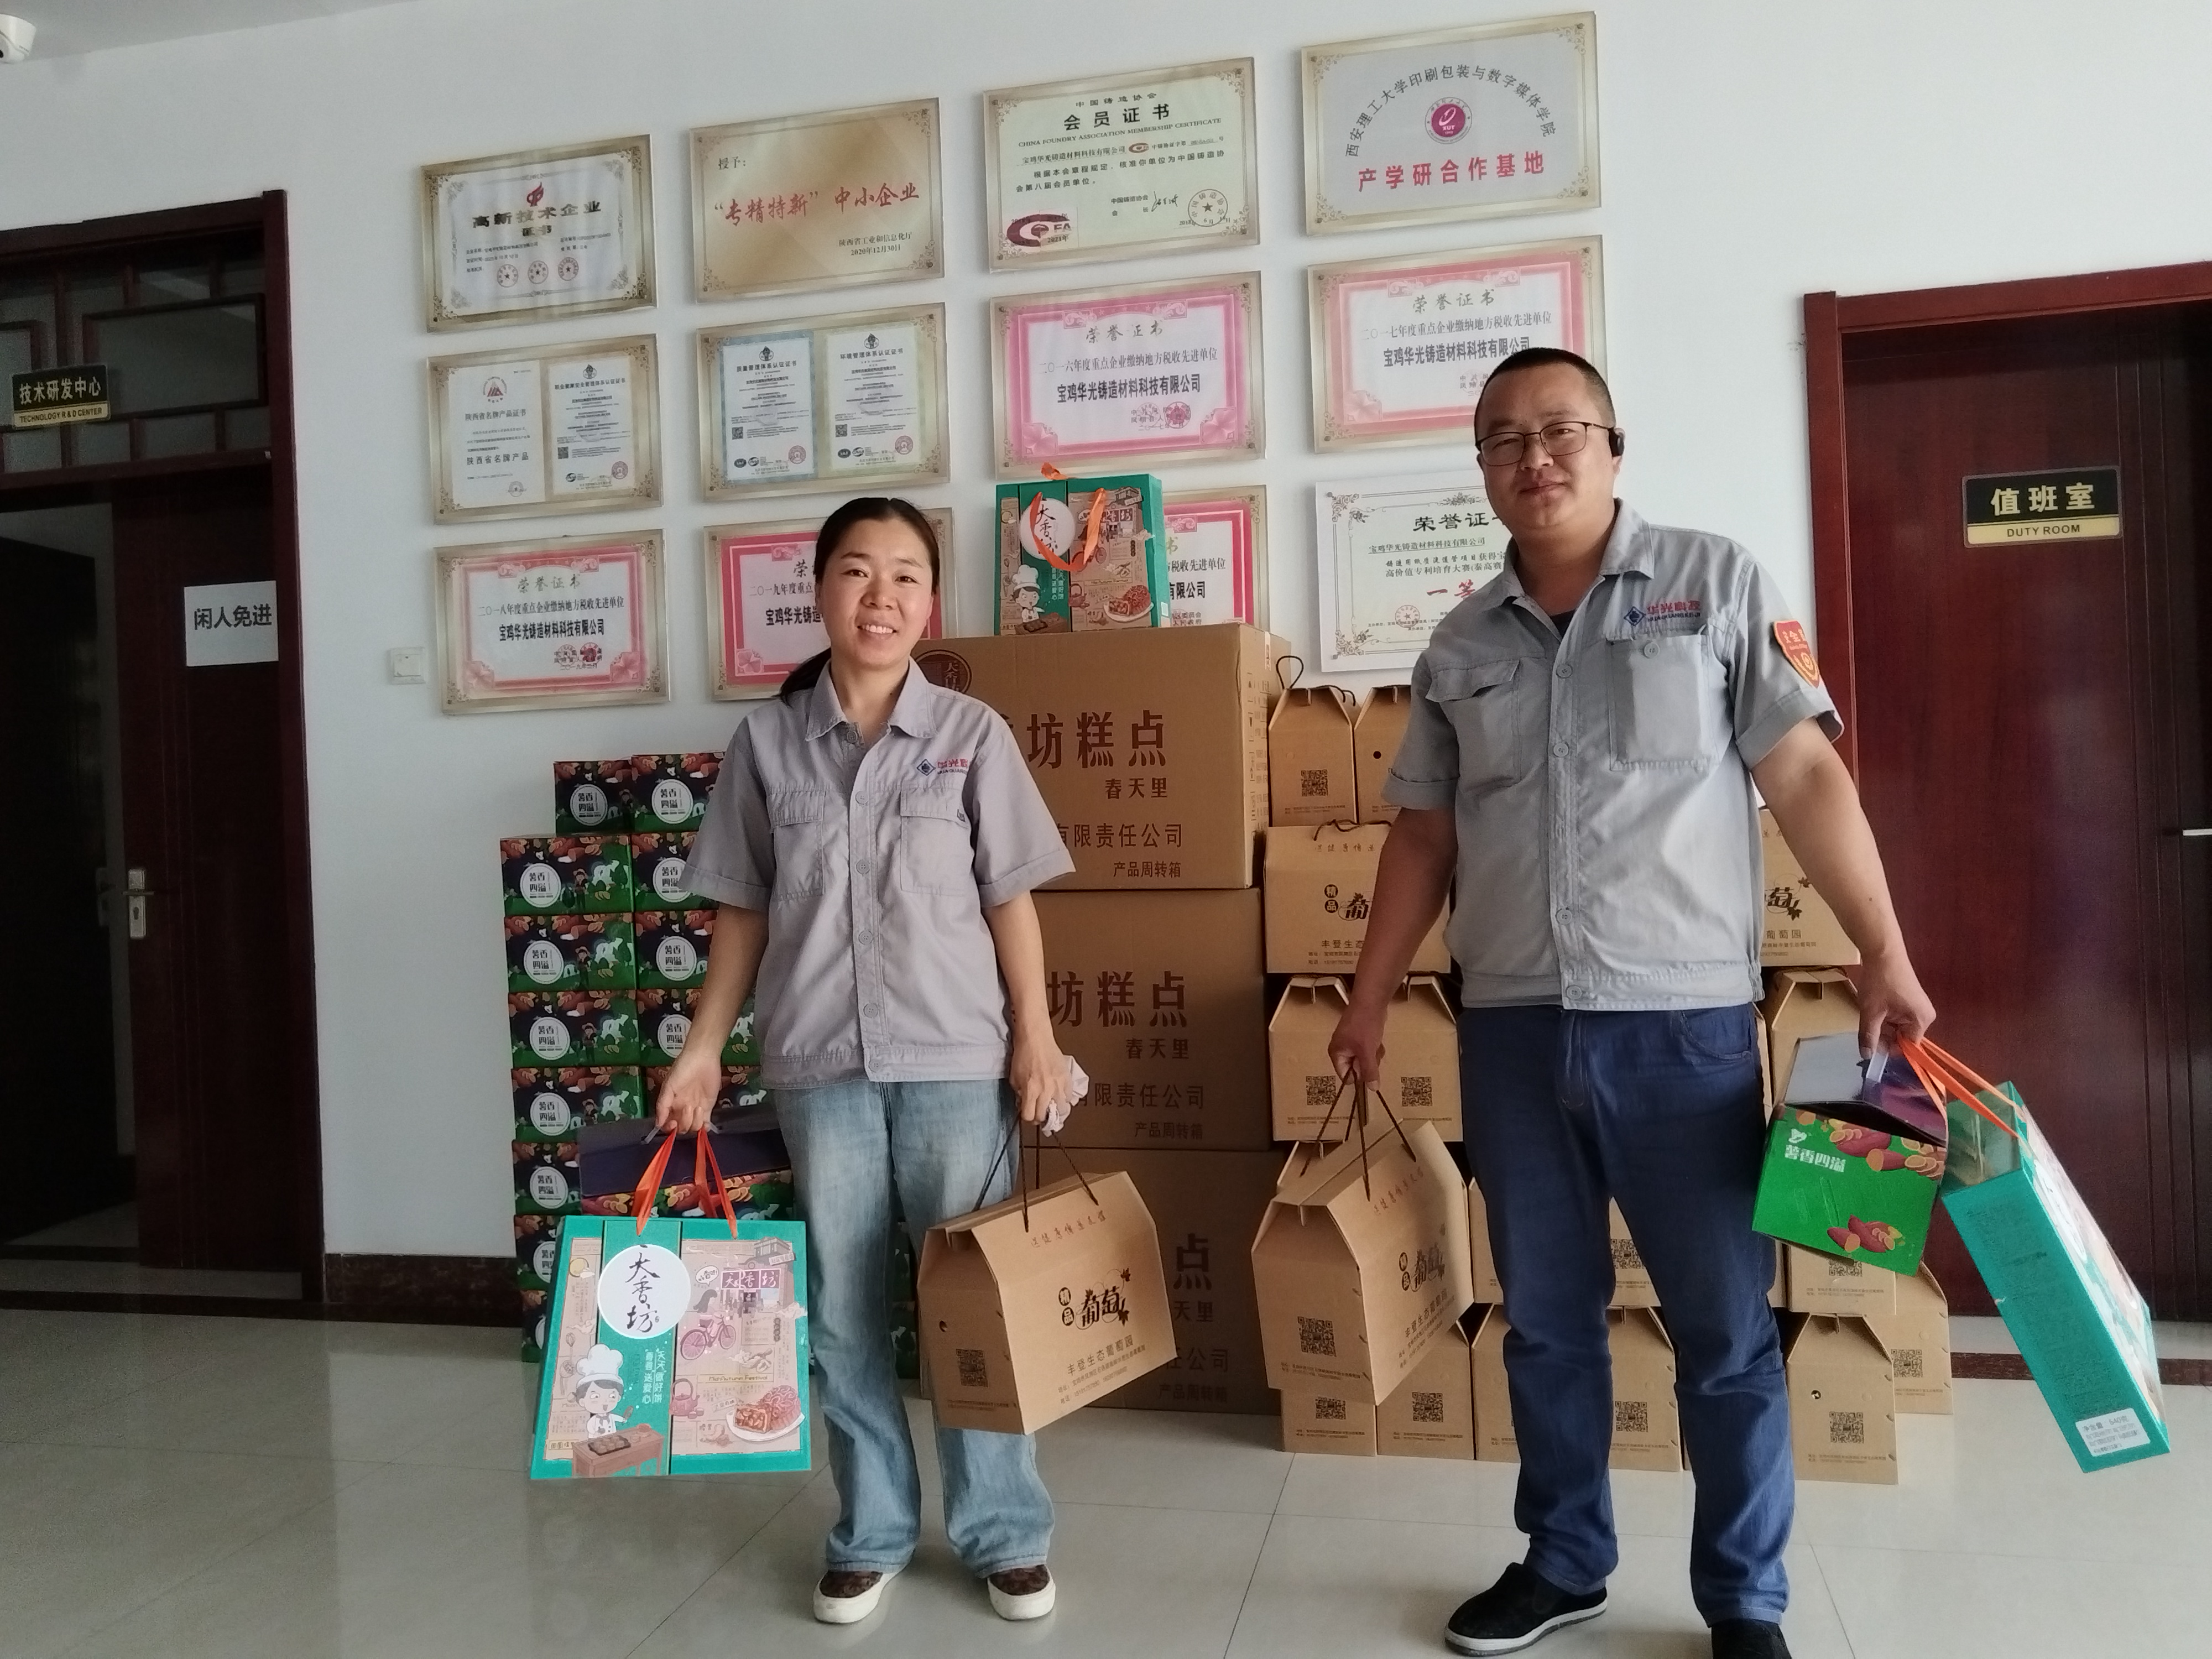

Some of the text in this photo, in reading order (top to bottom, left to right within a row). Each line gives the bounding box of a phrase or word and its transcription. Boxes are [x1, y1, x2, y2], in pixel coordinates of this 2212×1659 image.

[1076, 92, 1157, 108] 中国铸造协会
[1345, 64, 1557, 158] 西安理工大学印刷包装与数字媒体学院
[1064, 103, 1170, 131] 会员证书
[1019, 117, 1222, 148] CHINA FOUNDRY ASSOCIATION MEMBERSHIP CERTIFICATE
[1022, 145, 1126, 164] 宝鸡华光铸造材料科技有限公司
[1358, 150, 1545, 192] 产学研合作基地
[834, 182, 920, 214] 中小企业
[472, 200, 601, 228] 高新技术企业
[839, 232, 912, 247] 陕西省工业和信息化厅
[1412, 288, 1495, 314] 荣誉证书
[1086, 320, 1163, 343] 荣誉证书
[1384, 336, 1530, 367] 宝鸡华光铸造材料科技有限公司
[19, 376, 101, 405] 技术研发中心
[1057, 373, 1201, 404] 宝鸡华光铸造材料科技有限公司
[19, 411, 61, 423] TECHNOLOGY
[78, 407, 102, 417] CENTER
[466, 452, 529, 466] 陕西省名牌产品
[1990, 482, 2095, 516] 值班室
[1413, 512, 1502, 531] 荣誉证
[2007, 524, 2080, 538] DUTY ROOM
[1369, 537, 1485, 554] 宝鸡华光铸造材料科技有限公司
[194, 603, 273, 630] 闲人免进
[765, 606, 822, 626] 宝鸡华光铸造
[499, 618, 604, 641] 宝鸡华光铸造材料科技有限公司
[1019, 709, 1166, 769] 坊糕点
[1105, 778, 1167, 799] 春天里
[1113, 860, 1181, 878] 产品周转箱
[1047, 971, 1187, 1027] 坊糕点
[1126, 1038, 1190, 1059] 春天里
[1135, 1121, 1203, 1140] 产品周转箱
[1785, 1145, 1846, 1172] 薯香四溢
[1173, 1233, 1212, 1290] 点
[1174, 1301, 1213, 1322] 天里
[1067, 1334, 1133, 1376] 丰登生态葡萄园
